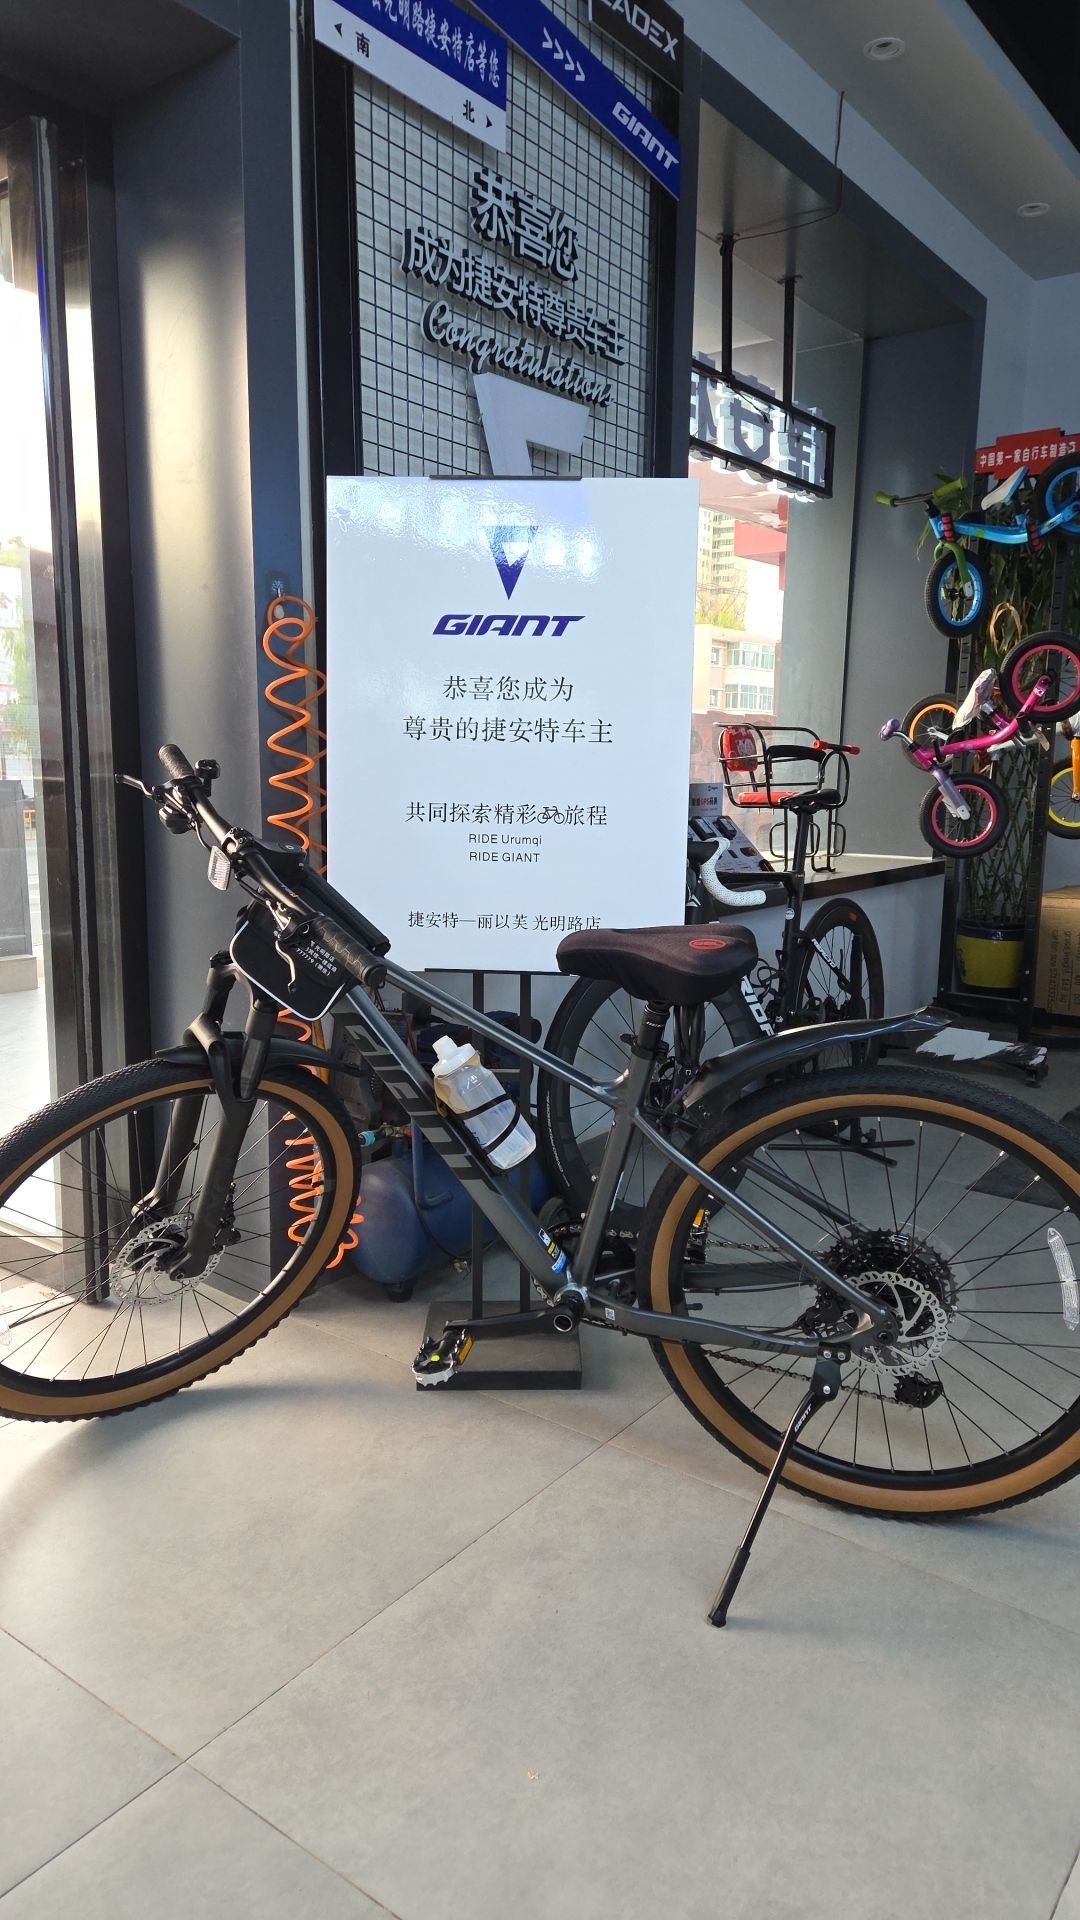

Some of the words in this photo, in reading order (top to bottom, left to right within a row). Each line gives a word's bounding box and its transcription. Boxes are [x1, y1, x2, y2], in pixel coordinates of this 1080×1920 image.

[600, 0, 678, 61] ADEX
[355, 32, 370, 58] 南
[463, 99, 475, 123] 北
[612, 101, 679, 169] GIANT
[472, 168, 579, 281] 恭喜您
[402, 228, 626, 364] 成为捷安特尊贵车主
[422, 300, 615, 408] Congratulations
[433, 614, 586, 636] GIANT
[443, 675, 574, 702] 恭喜您成为
[403, 716, 613, 743] 尊贵的捷安特车主
[468, 833, 498, 844] RIDE
[501, 834, 542, 848] Urumqi
[469, 851, 499, 862] RIDE
[502, 852, 540, 863] GIANT
[334, 1012, 502, 1195] GIANT
